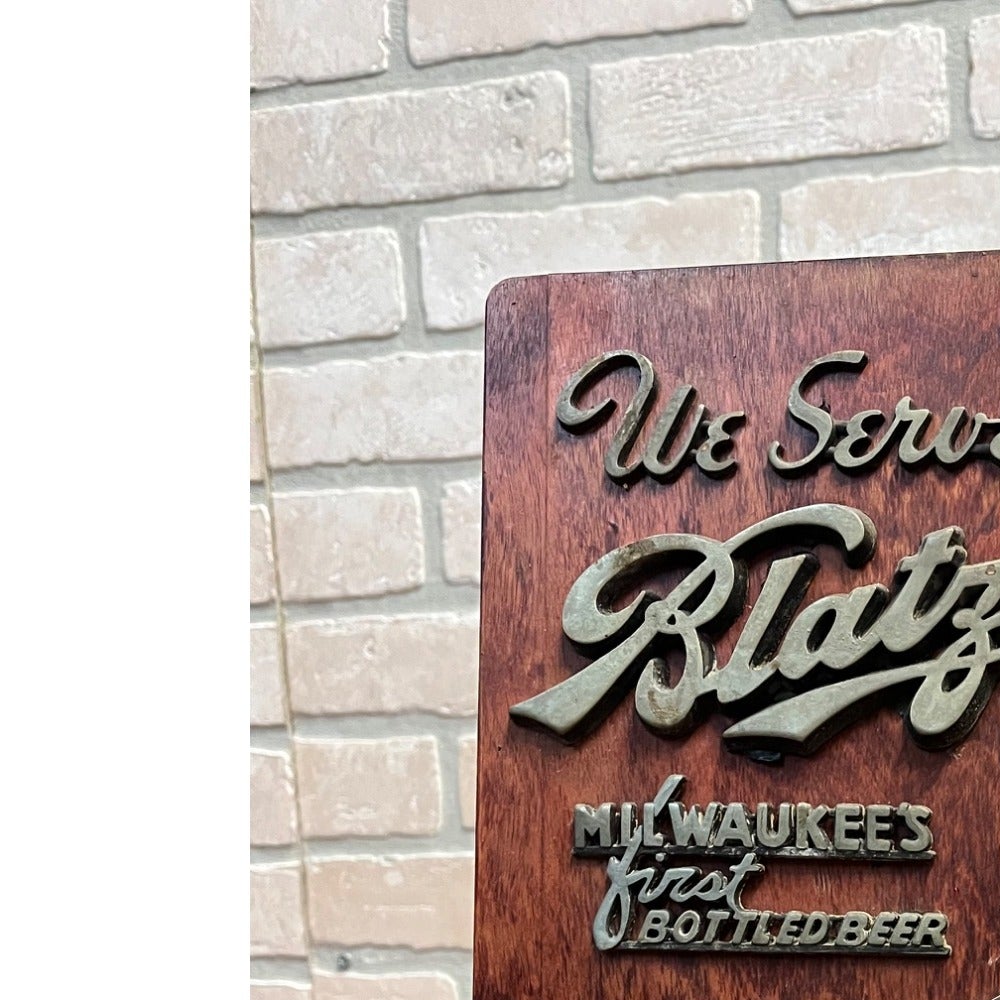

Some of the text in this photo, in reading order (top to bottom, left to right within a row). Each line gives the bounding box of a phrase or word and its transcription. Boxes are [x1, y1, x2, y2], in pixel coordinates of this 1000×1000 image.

[573, 800, 935, 854] MILWAUKEE'S
[594, 774, 767, 951] first
[637, 908, 950, 949] BOTTLED BEER
